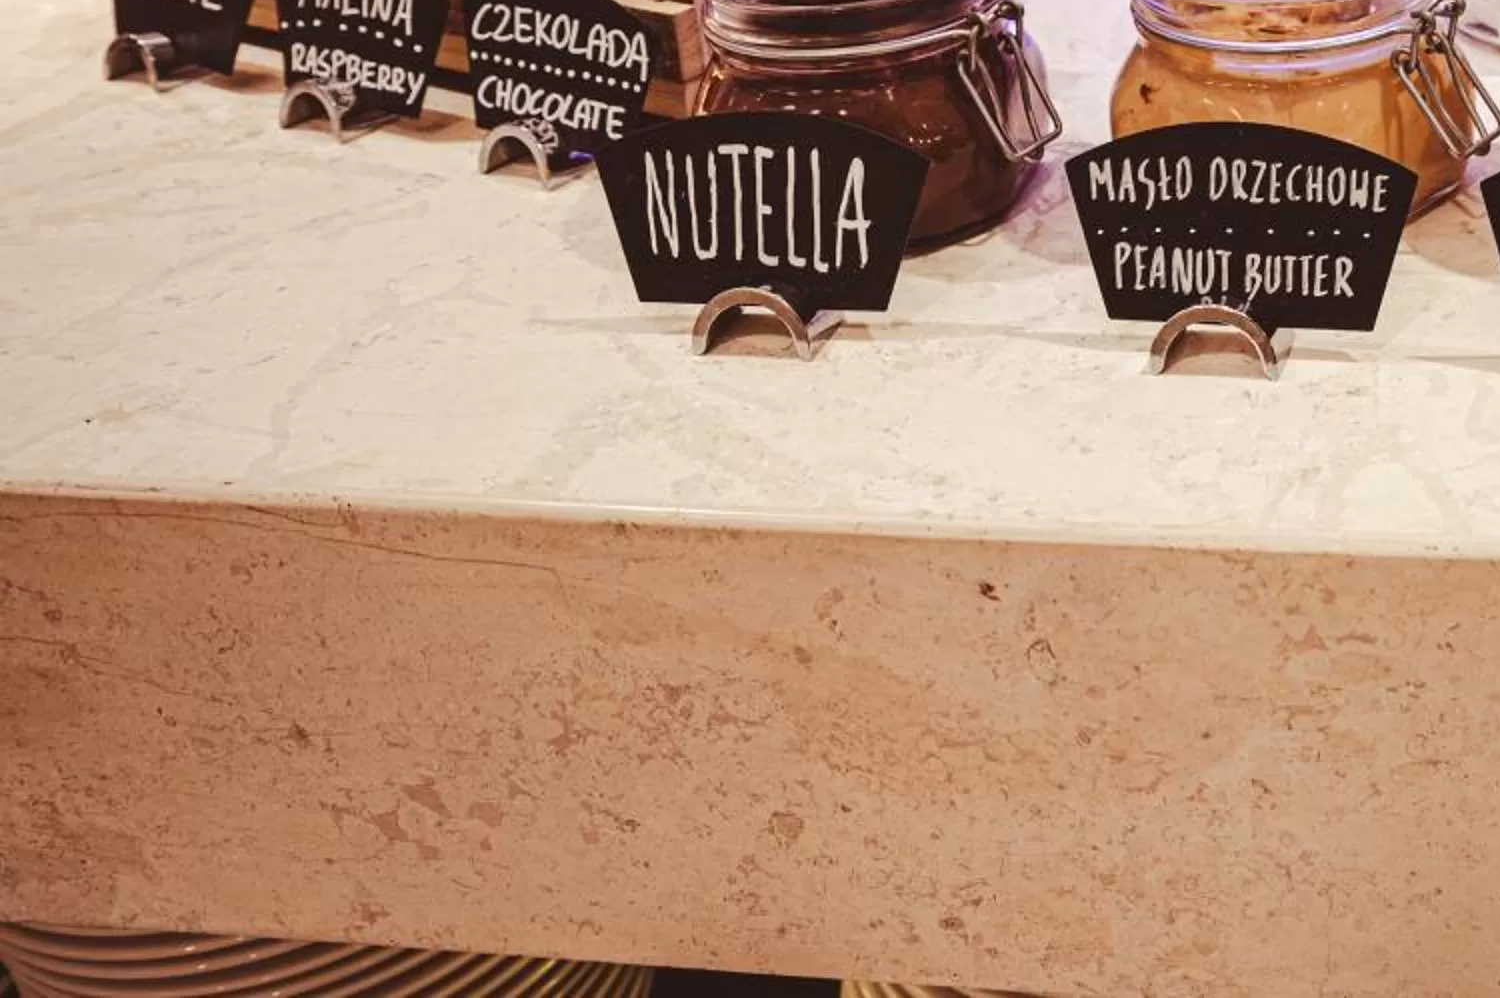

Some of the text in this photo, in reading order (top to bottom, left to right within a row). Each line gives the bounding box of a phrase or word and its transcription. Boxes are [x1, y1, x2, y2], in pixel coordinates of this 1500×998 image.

[291, 42, 426, 105] RASPBERRY
[471, 3, 650, 82] CZEKOLADA
[477, 75, 627, 140] CHOCOLATE
[644, 143, 872, 273] NUTELLA
[1089, 155, 1391, 214] MASŁO ORZECHOWE
[1113, 241, 1355, 303] PEANUT BUTTER
